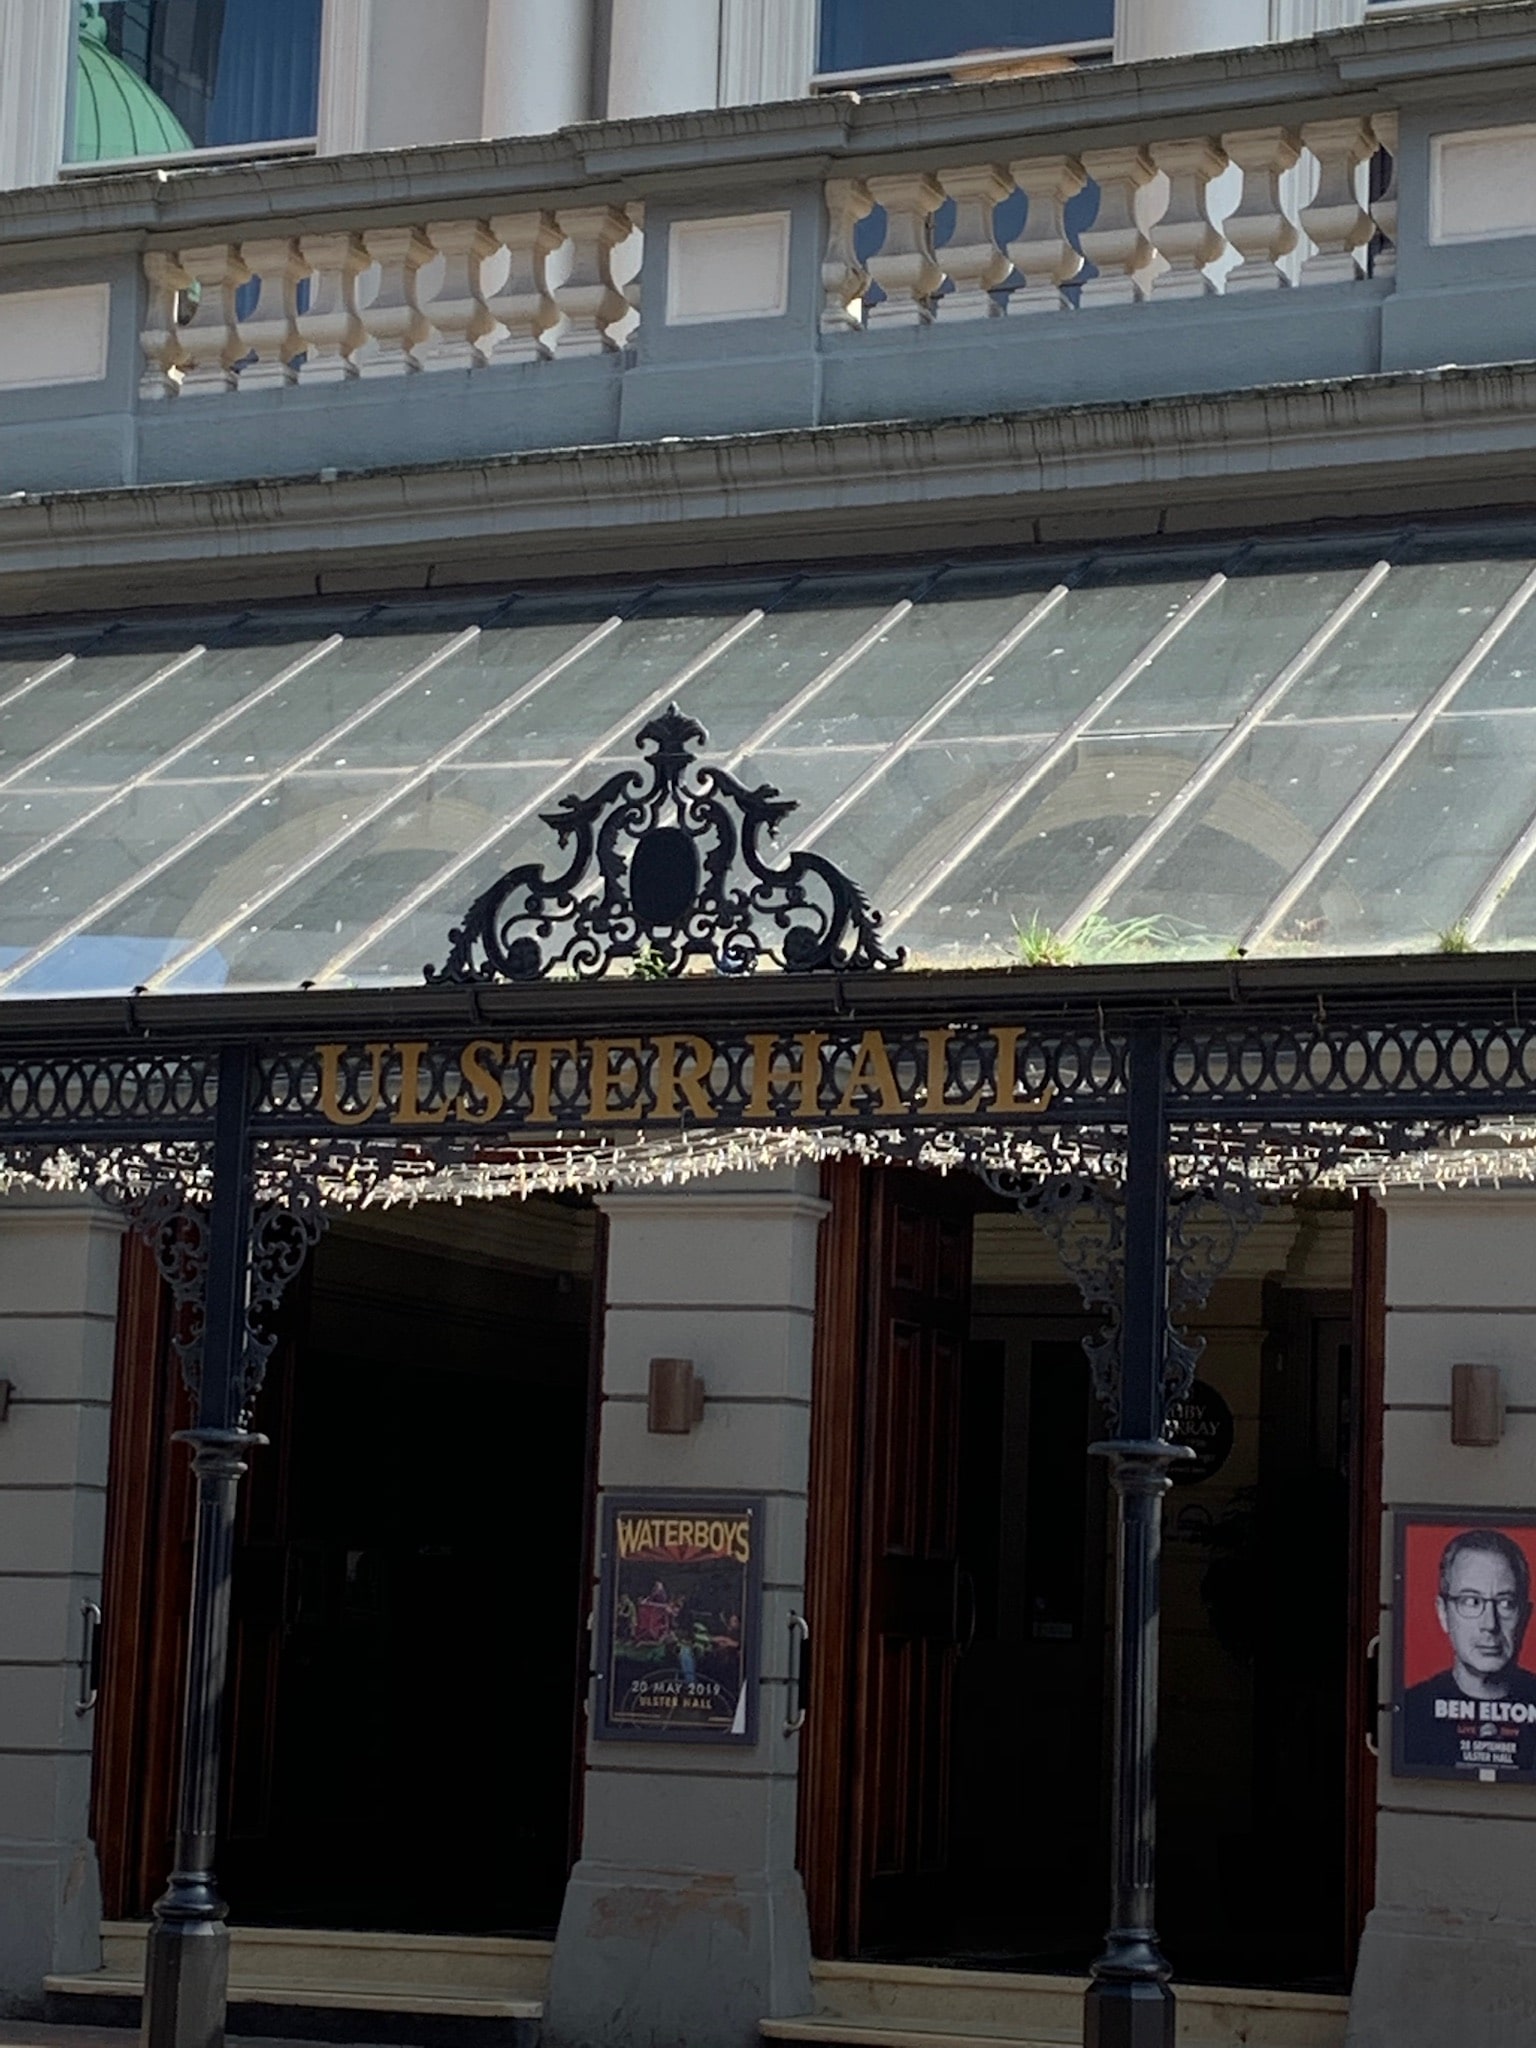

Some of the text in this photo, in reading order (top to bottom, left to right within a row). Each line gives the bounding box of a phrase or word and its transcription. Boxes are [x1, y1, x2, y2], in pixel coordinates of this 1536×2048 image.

[314, 1026, 1054, 1126] ULSTER HALL
[617, 1517, 750, 1564] WATERBOYS
[631, 1680, 721, 1696] 20 MAY 2019
[639, 1696, 713, 1710] ULSTER HALL
[1434, 1699, 1475, 1720] BEN
[1473, 1740, 1517, 1753] SEPTEMBER
[1462, 1751, 1514, 1764] ULSTER HALL
